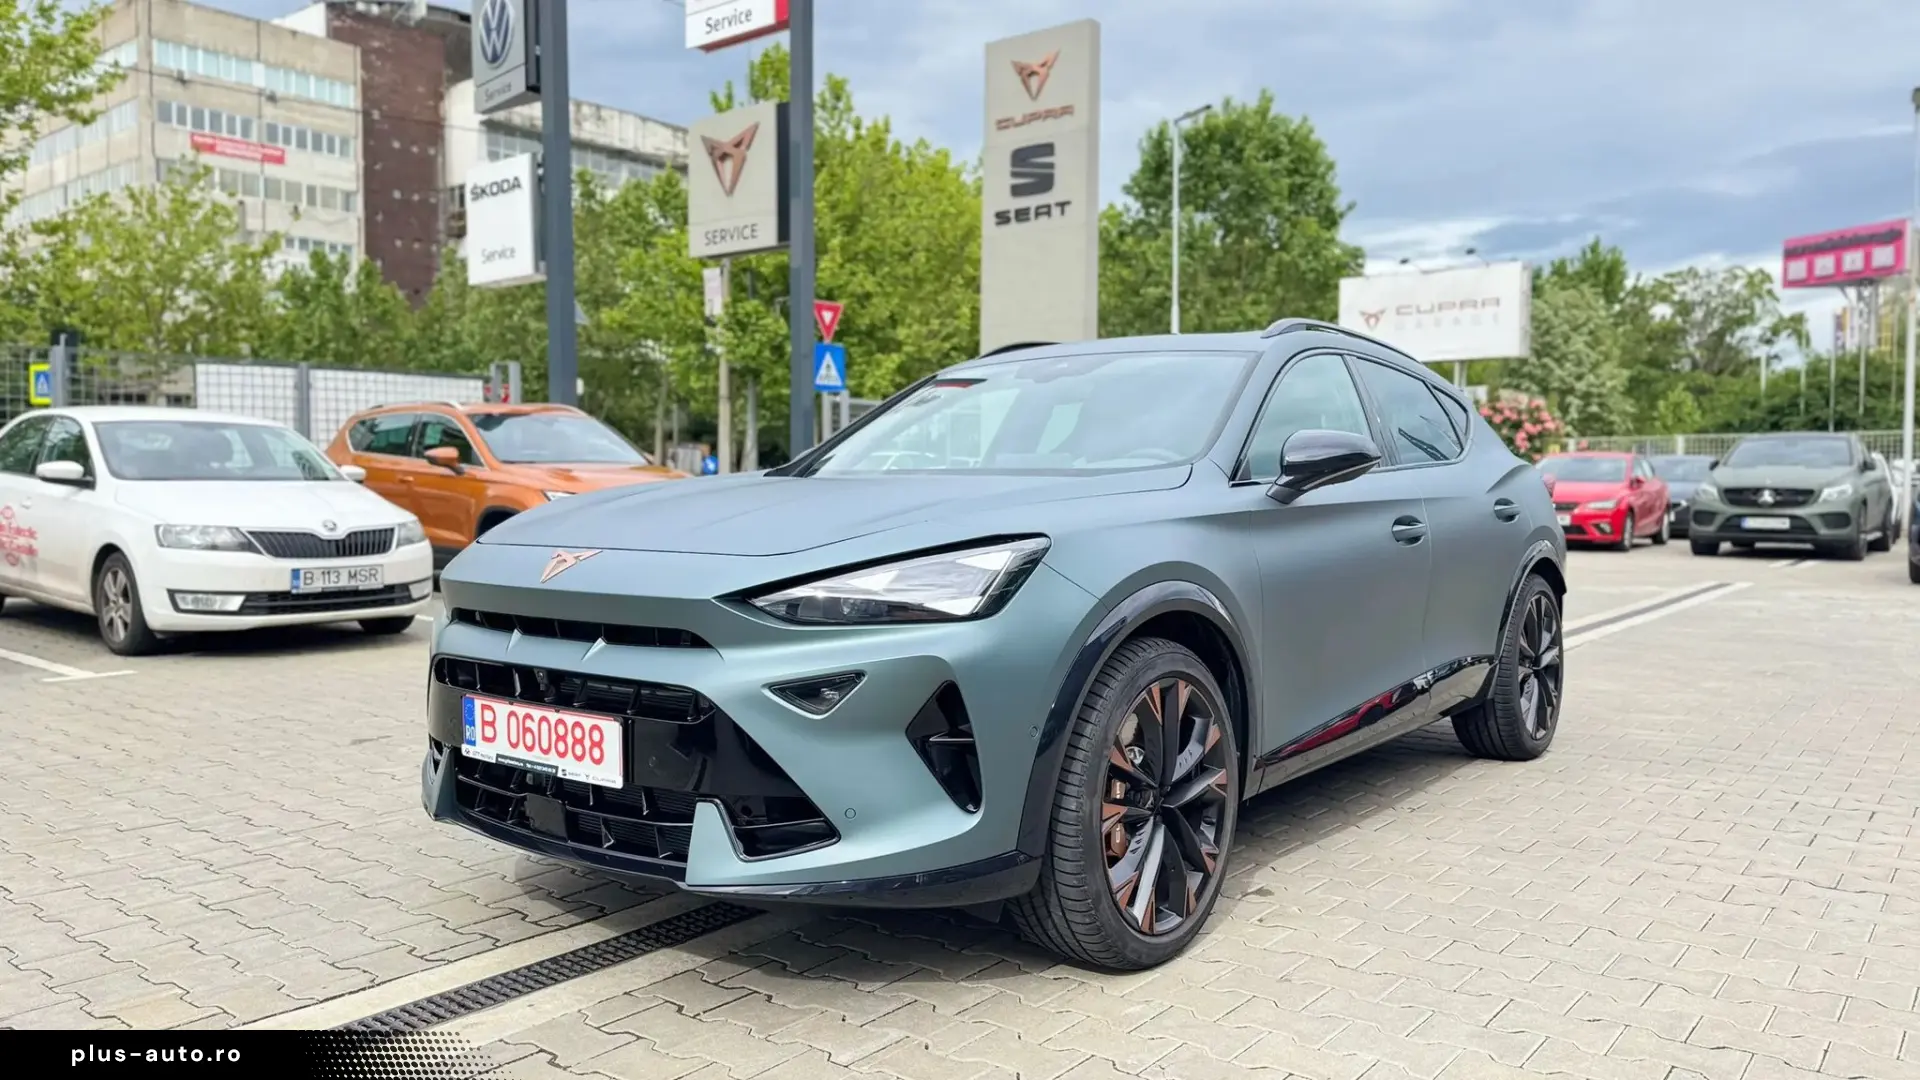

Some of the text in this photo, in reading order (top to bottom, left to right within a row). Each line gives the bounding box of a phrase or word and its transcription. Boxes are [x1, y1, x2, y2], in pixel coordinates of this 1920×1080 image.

[704, 8, 753, 35] Service
[994, 104, 1075, 131] CUPRA
[993, 200, 1072, 227] SEAT
[704, 223, 759, 247] SERVICE
[481, 244, 516, 265] Service
[1395, 296, 1501, 316] CUPRA
[303, 566, 379, 586] B 113 MSR
[480, 703, 605, 766] B 060888
